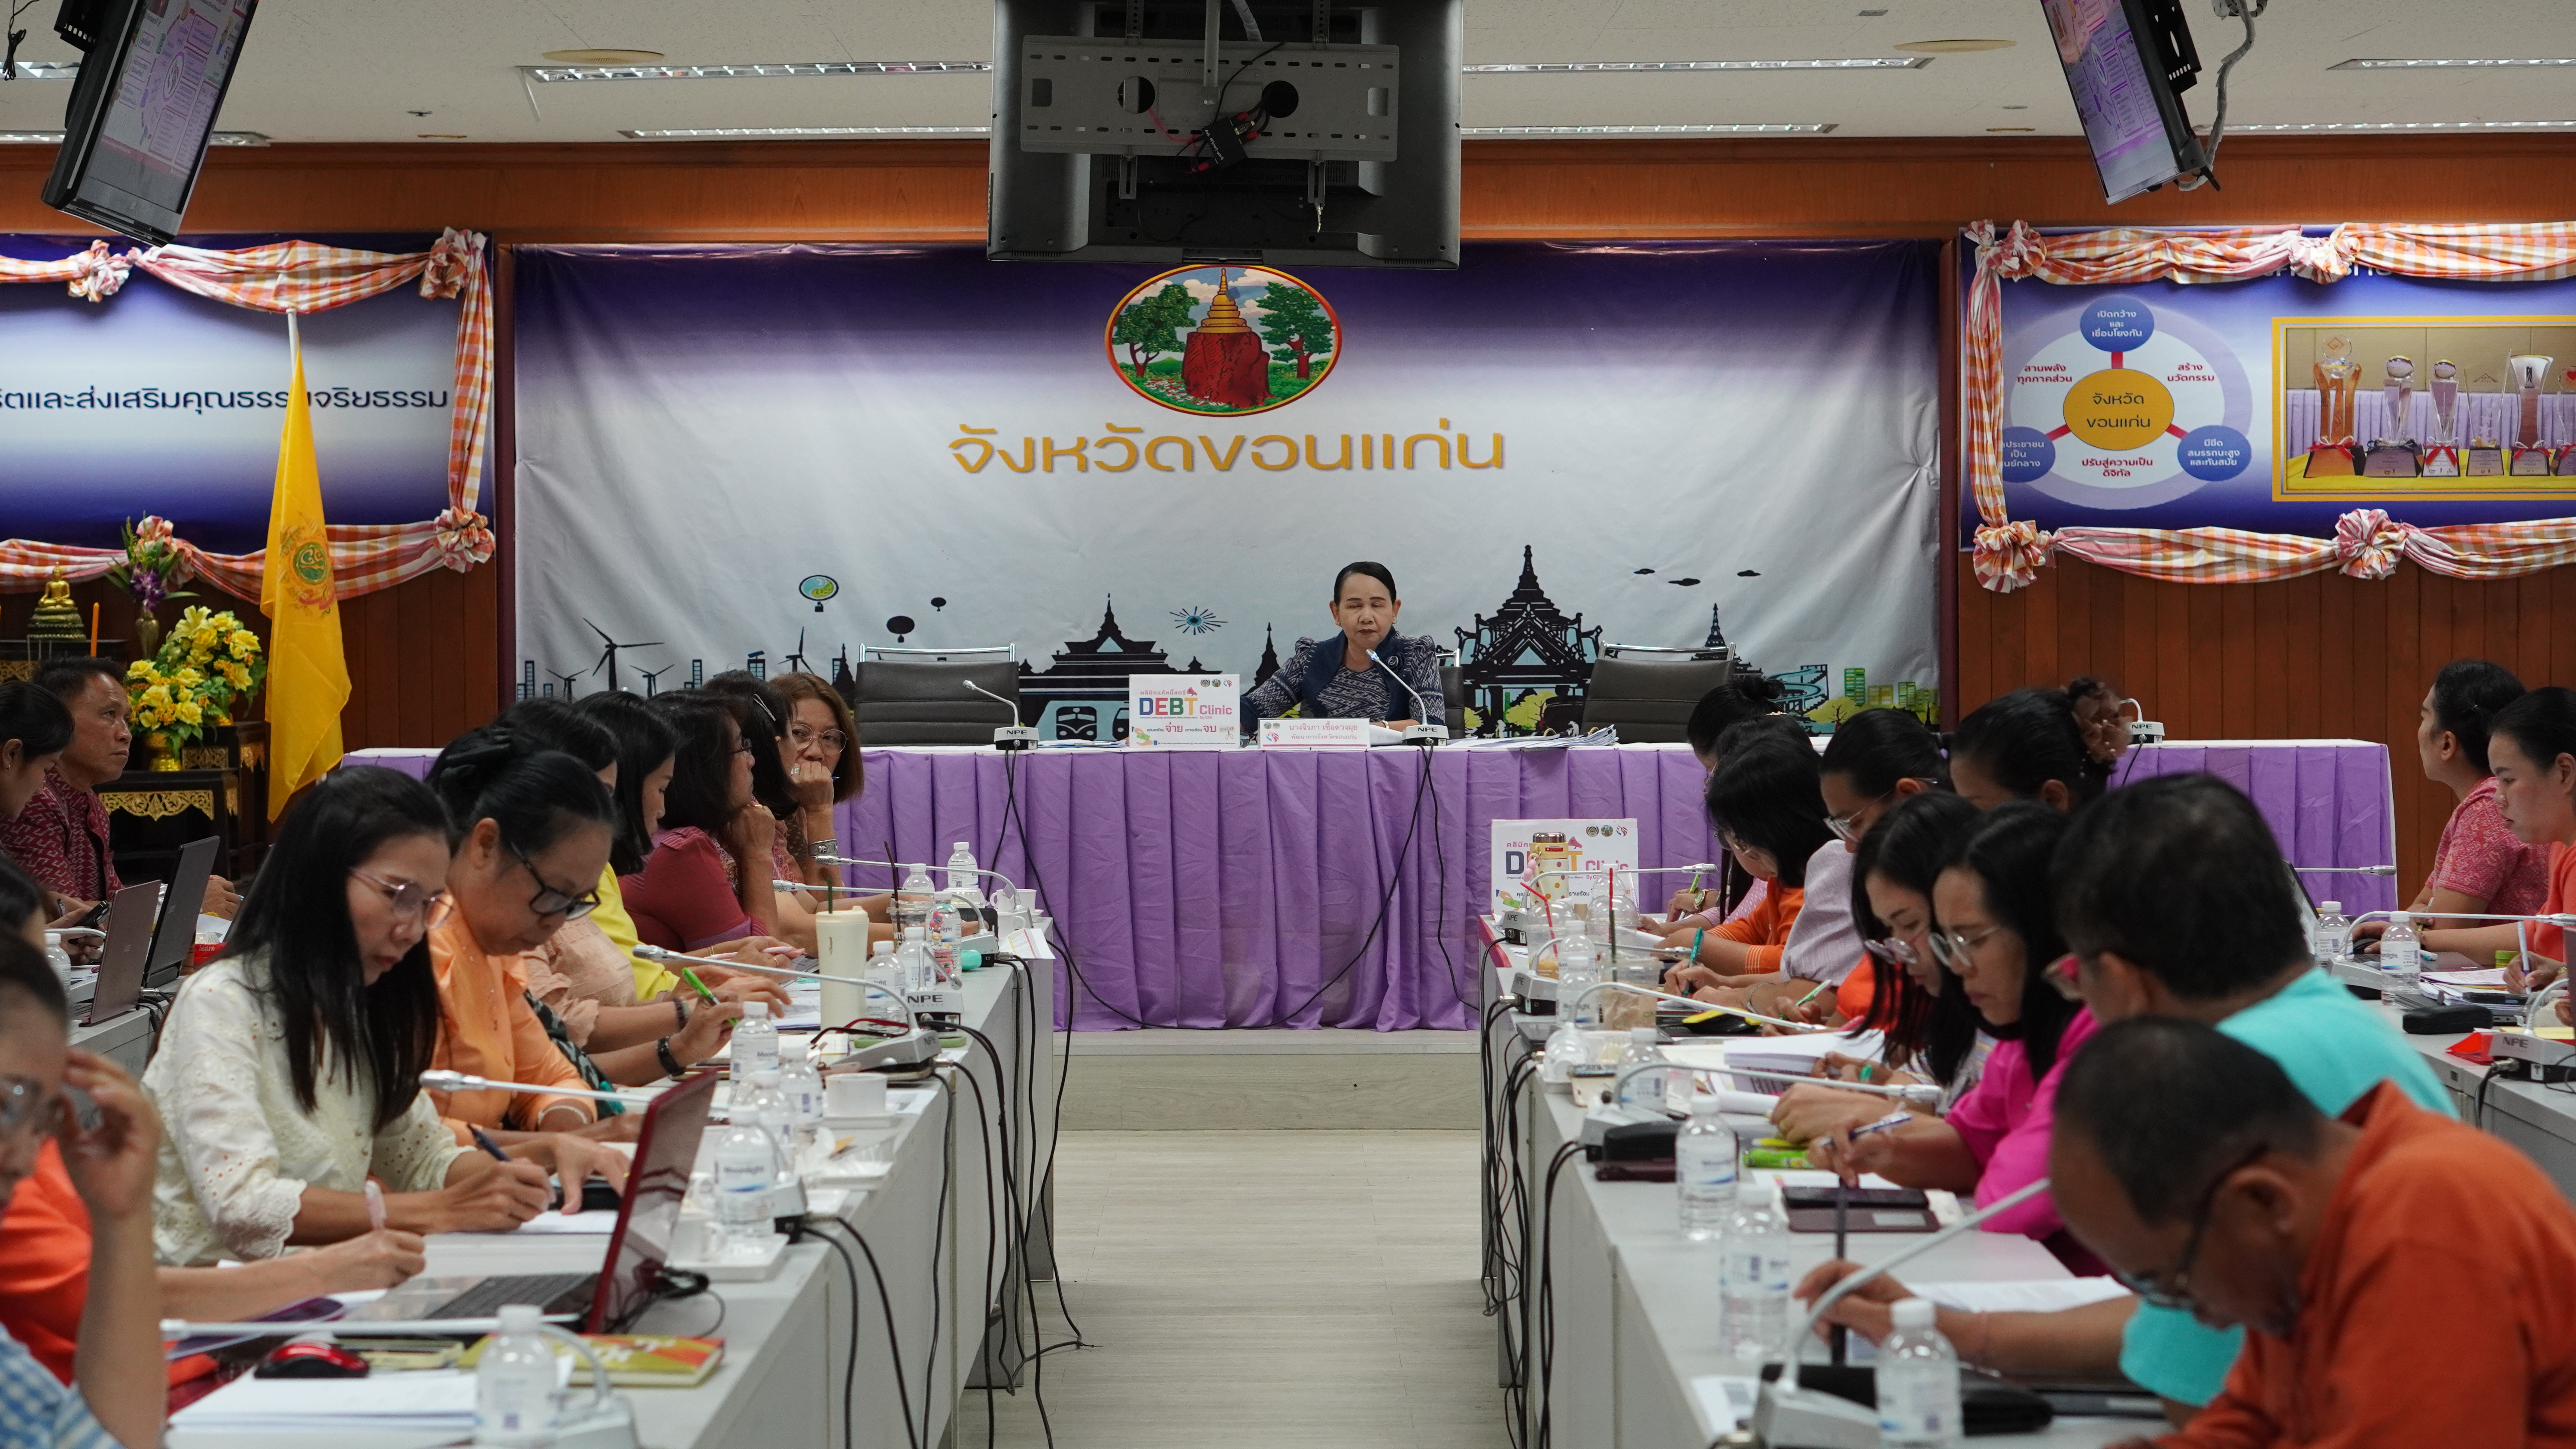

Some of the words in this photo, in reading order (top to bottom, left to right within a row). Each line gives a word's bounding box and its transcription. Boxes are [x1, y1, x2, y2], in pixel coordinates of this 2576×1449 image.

[2024, 363, 2066, 373] สานพลัง
[2178, 363, 2202, 371] สร้าง
[2167, 372, 2215, 382] นวัตกรรม
[0, 385, 447, 414] ตและส่งเสริมคุณธรรจริยธรรม
[2093, 392, 2144, 405] จังหวัด
[2087, 415, 2151, 428] ขอนแก่น
[948, 418, 1503, 473] จังหวัดขอนแก่น
[2011, 449, 2026, 458] เป็น
[2003, 459, 2041, 467] นย์กลาง
[2103, 468, 2131, 477] ดิจิทัล
[1139, 697, 1198, 715] DEBT
[1200, 705, 1232, 715] Clinic
[1165, 722, 1182, 733] จ่าย
[1506, 851, 1583, 874] DT
[908, 994, 943, 1003] NPE
[2503, 1037, 2529, 1048] NPE
